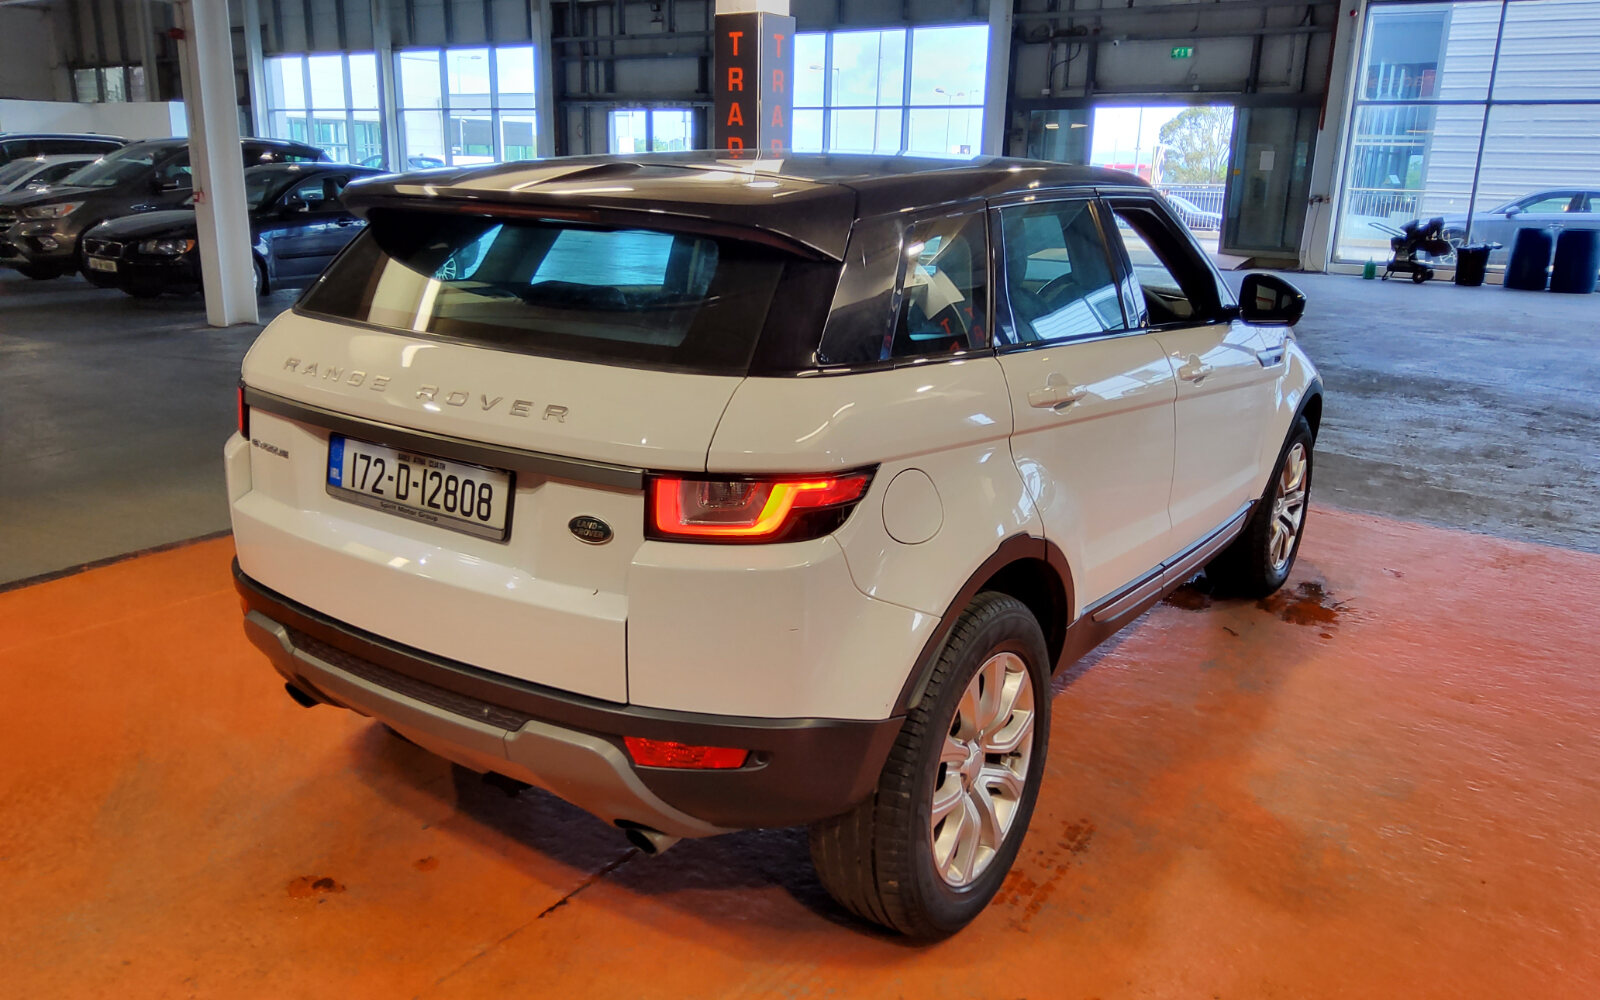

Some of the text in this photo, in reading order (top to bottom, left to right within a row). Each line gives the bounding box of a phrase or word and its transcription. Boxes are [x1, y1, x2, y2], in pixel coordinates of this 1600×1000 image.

[283, 357, 570, 423] RANGE ROVER
[352, 452, 493, 522] 172-D-12808
[576, 519, 598, 530] LAND
[578, 527, 605, 539] ROVER
